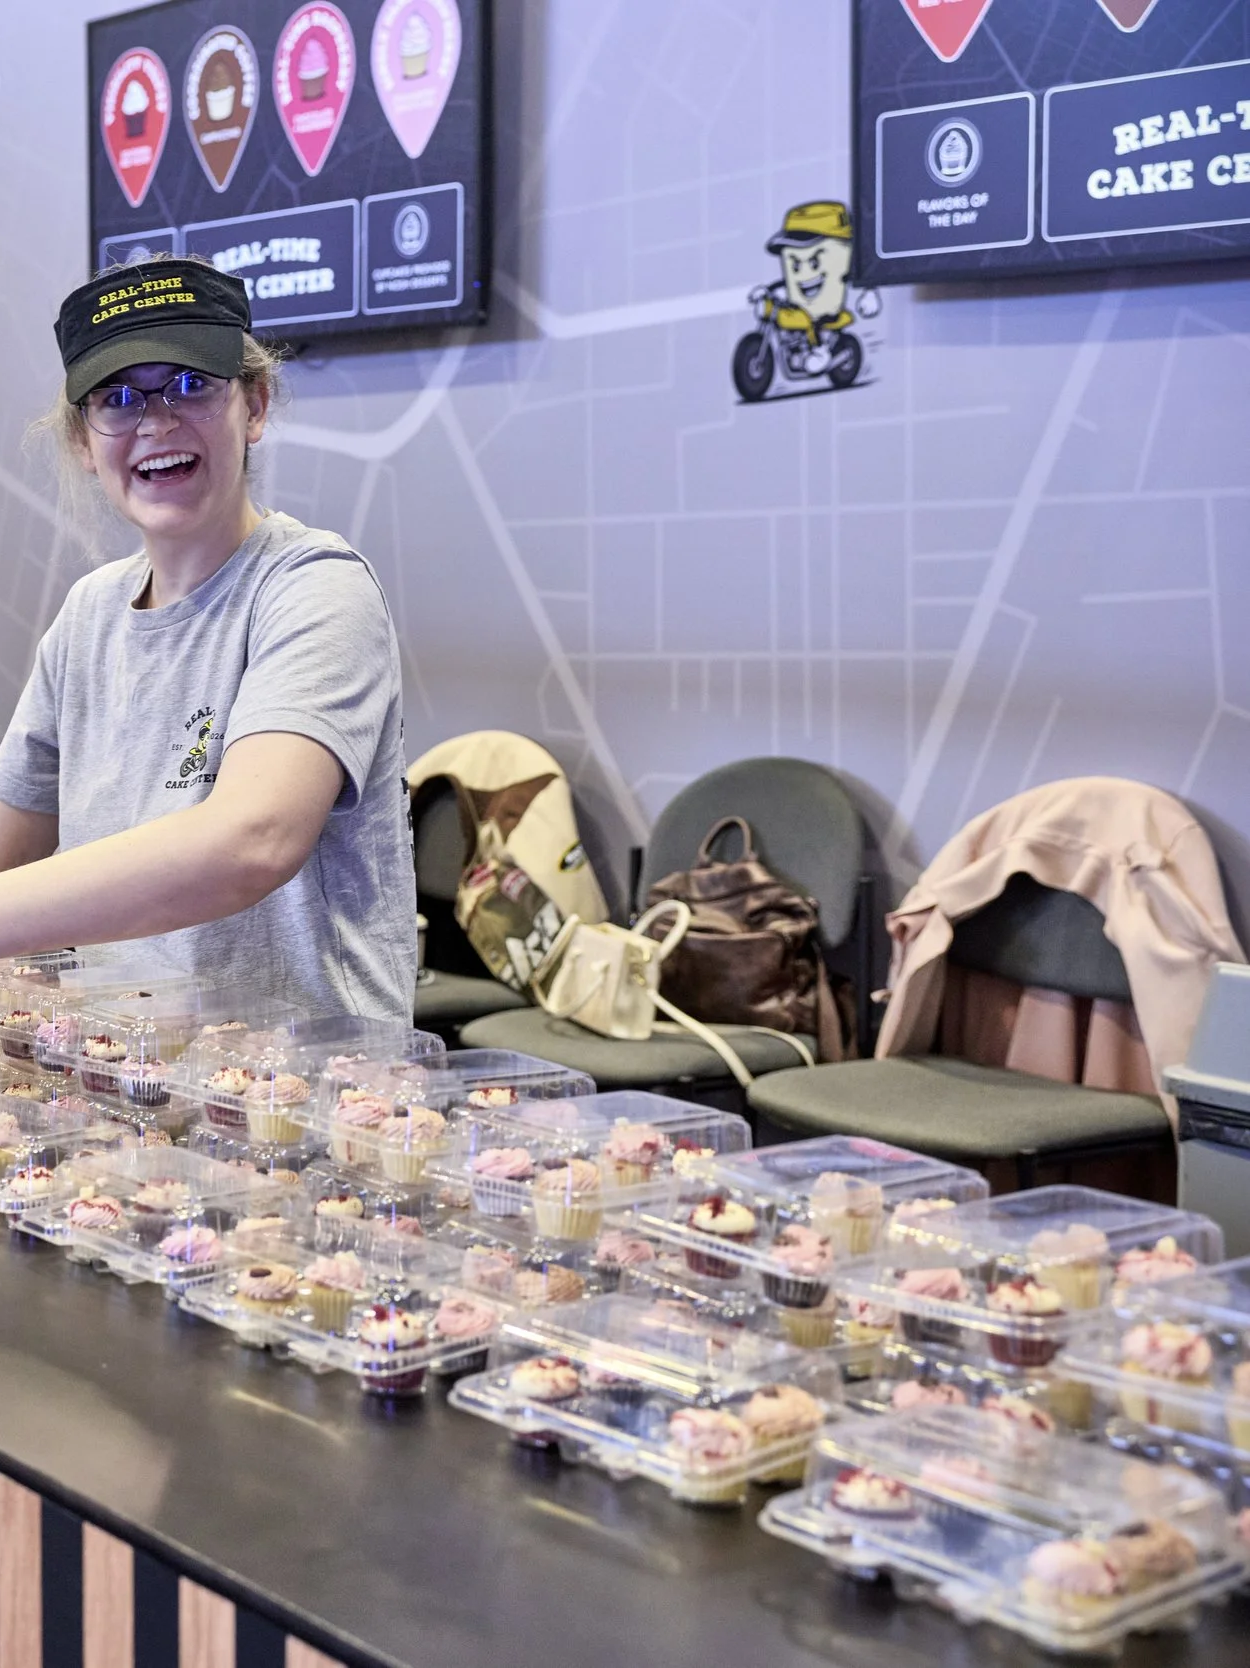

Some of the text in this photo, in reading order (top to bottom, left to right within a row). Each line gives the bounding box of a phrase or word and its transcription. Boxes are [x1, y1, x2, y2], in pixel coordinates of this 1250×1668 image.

[1087, 159, 1194, 199] CAKE
[970, 192, 989, 208] OF
[928, 210, 979, 228] THE DAY
[99, 277, 182, 306] REAL-TIME
[255, 267, 335, 299] CENTER
[92, 293, 196, 324] CAKE CENTER
[165, 780, 190, 789] CAKE
